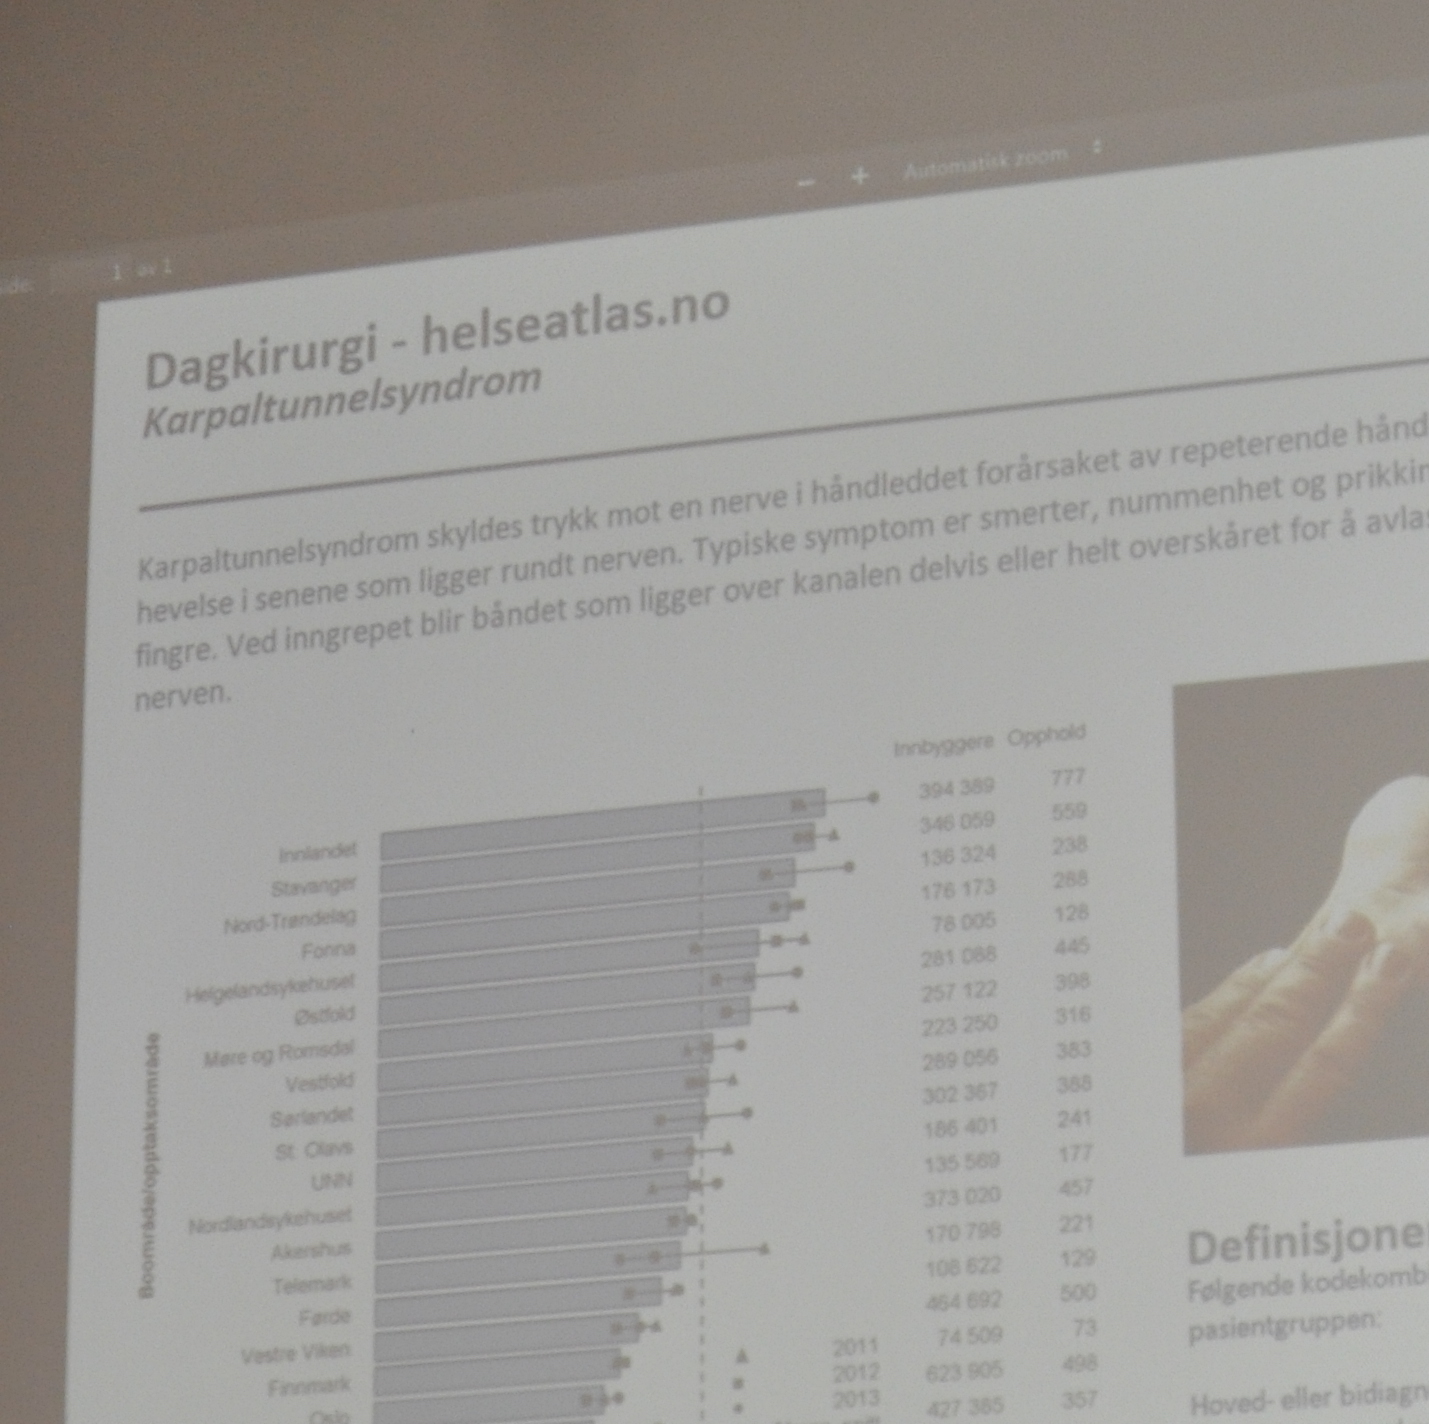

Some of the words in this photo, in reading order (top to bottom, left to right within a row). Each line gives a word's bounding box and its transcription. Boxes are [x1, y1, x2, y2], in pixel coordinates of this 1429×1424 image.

[1015, 145, 1069, 167] zoom
[145, 321, 378, 394] Dagkirurgi
[422, 289, 730, 357] helseatlas.no
[142, 365, 544, 441] Karpaltunnelsyndrom
[136, 530, 420, 584] Karpaltunnelsyndrom
[426, 515, 524, 552] skyldes
[529, 504, 600, 541] trykk
[606, 499, 662, 529] mot
[668, 497, 704, 523] en
[709, 488, 789, 517] nerve
[810, 464, 969, 505] håndleddet
[975, 448, 1121, 488] forårsaket
[1127, 447, 1162, 471] av
[1168, 421, 1349, 469] repeterende
[135, 591, 235, 626] hevelse
[254, 581, 350, 613] senene
[355, 574, 412, 602] som
[418, 565, 494, 599] ligger
[500, 551, 576, 585] rundt
[581, 544, 684, 576] nerven.
[691, 527, 797, 568] Typiske
[803, 516, 936, 556] symptom
[942, 511, 972, 536] er
[978, 498, 1099, 532] smerter,
[1107, 474, 1284, 517] nummenhet
[1290, 473, 1328, 503] og
[133, 640, 218, 673] fingre.
[225, 626, 278, 659] Ved
[284, 614, 414, 656] inngrepet
[419, 607, 466, 638] blir
[470, 597, 568, 632] båndet
[573, 593, 633, 621] som
[639, 584, 716, 619] ligger
[721, 576, 786, 605] over
[791, 561, 903, 597] kanalen
[907, 550, 990, 585] delvis
[996, 544, 1060, 575] eller
[1066, 535, 1121, 567] helt
[1127, 519, 1283, 561] overskåret
[1288, 514, 1332, 543] for
[134, 682, 232, 713] nerven.
[1005, 722, 1088, 750] Opphold
[1050, 765, 1088, 788] 777
[278, 840, 358, 865] Innlandet
[269, 875, 358, 899] Stavanger
[299, 941, 359, 961] Fonna
[293, 1004, 357, 1028] Østfold
[250, 1048, 276, 1069] og
[277, 1038, 356, 1061] Romsdal
[284, 1070, 357, 1095] Vestfold
[309, 1170, 355, 1193] UNN
[187, 1205, 354, 1236] Nordlandsykehuset
[269, 1240, 354, 1262] Akershus
[272, 1272, 354, 1296] Telemark
[1186, 1272, 1296, 1307] Følgende
[298, 1307, 353, 1329] Førde
[239, 1345, 298, 1366] Vestre
[301, 1342, 353, 1361] Viken
[831, 1335, 879, 1359] 2011
[831, 1360, 881, 1385] 2012
[266, 1373, 352, 1398] Finnmark
[1278, 1384, 1333, 1412] eller
[832, 1387, 882, 1411] 2013
